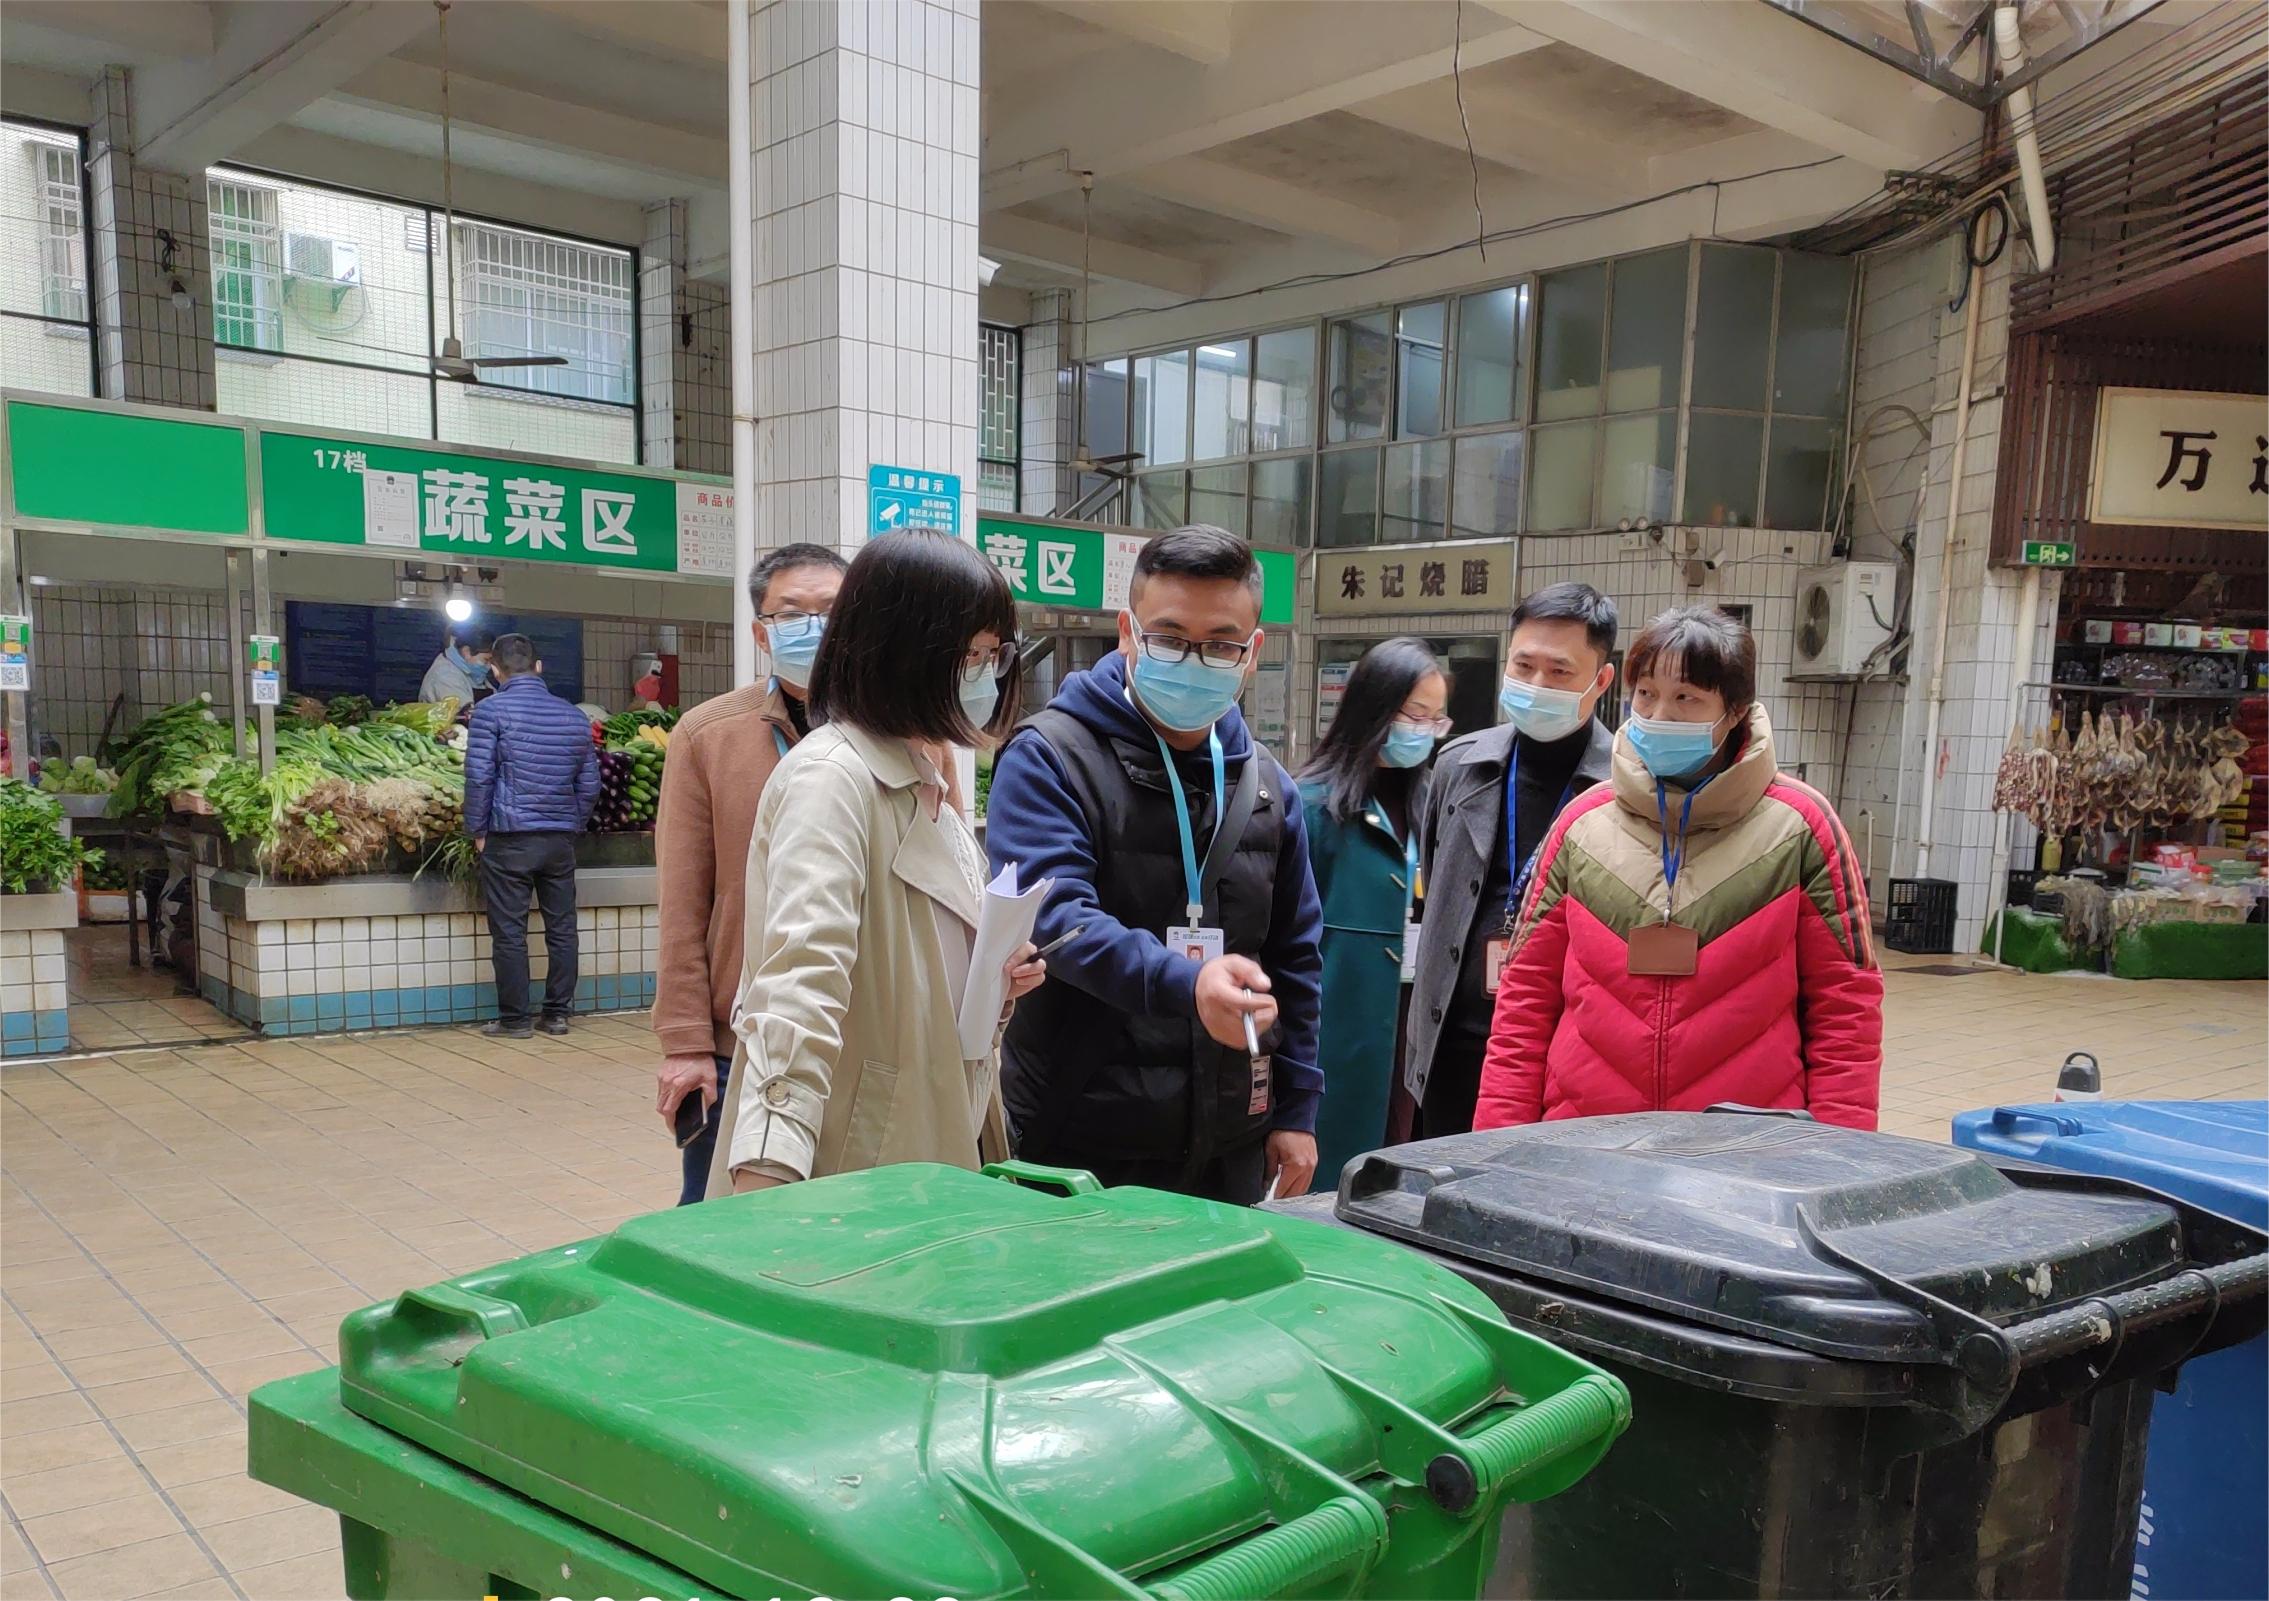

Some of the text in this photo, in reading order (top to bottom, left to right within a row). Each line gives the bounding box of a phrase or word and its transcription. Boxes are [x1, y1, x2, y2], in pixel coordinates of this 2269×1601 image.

[313, 449, 367, 473] 17档
[422, 468, 638, 556] 蔬菜区
[984, 533, 1077, 596] 菜区
